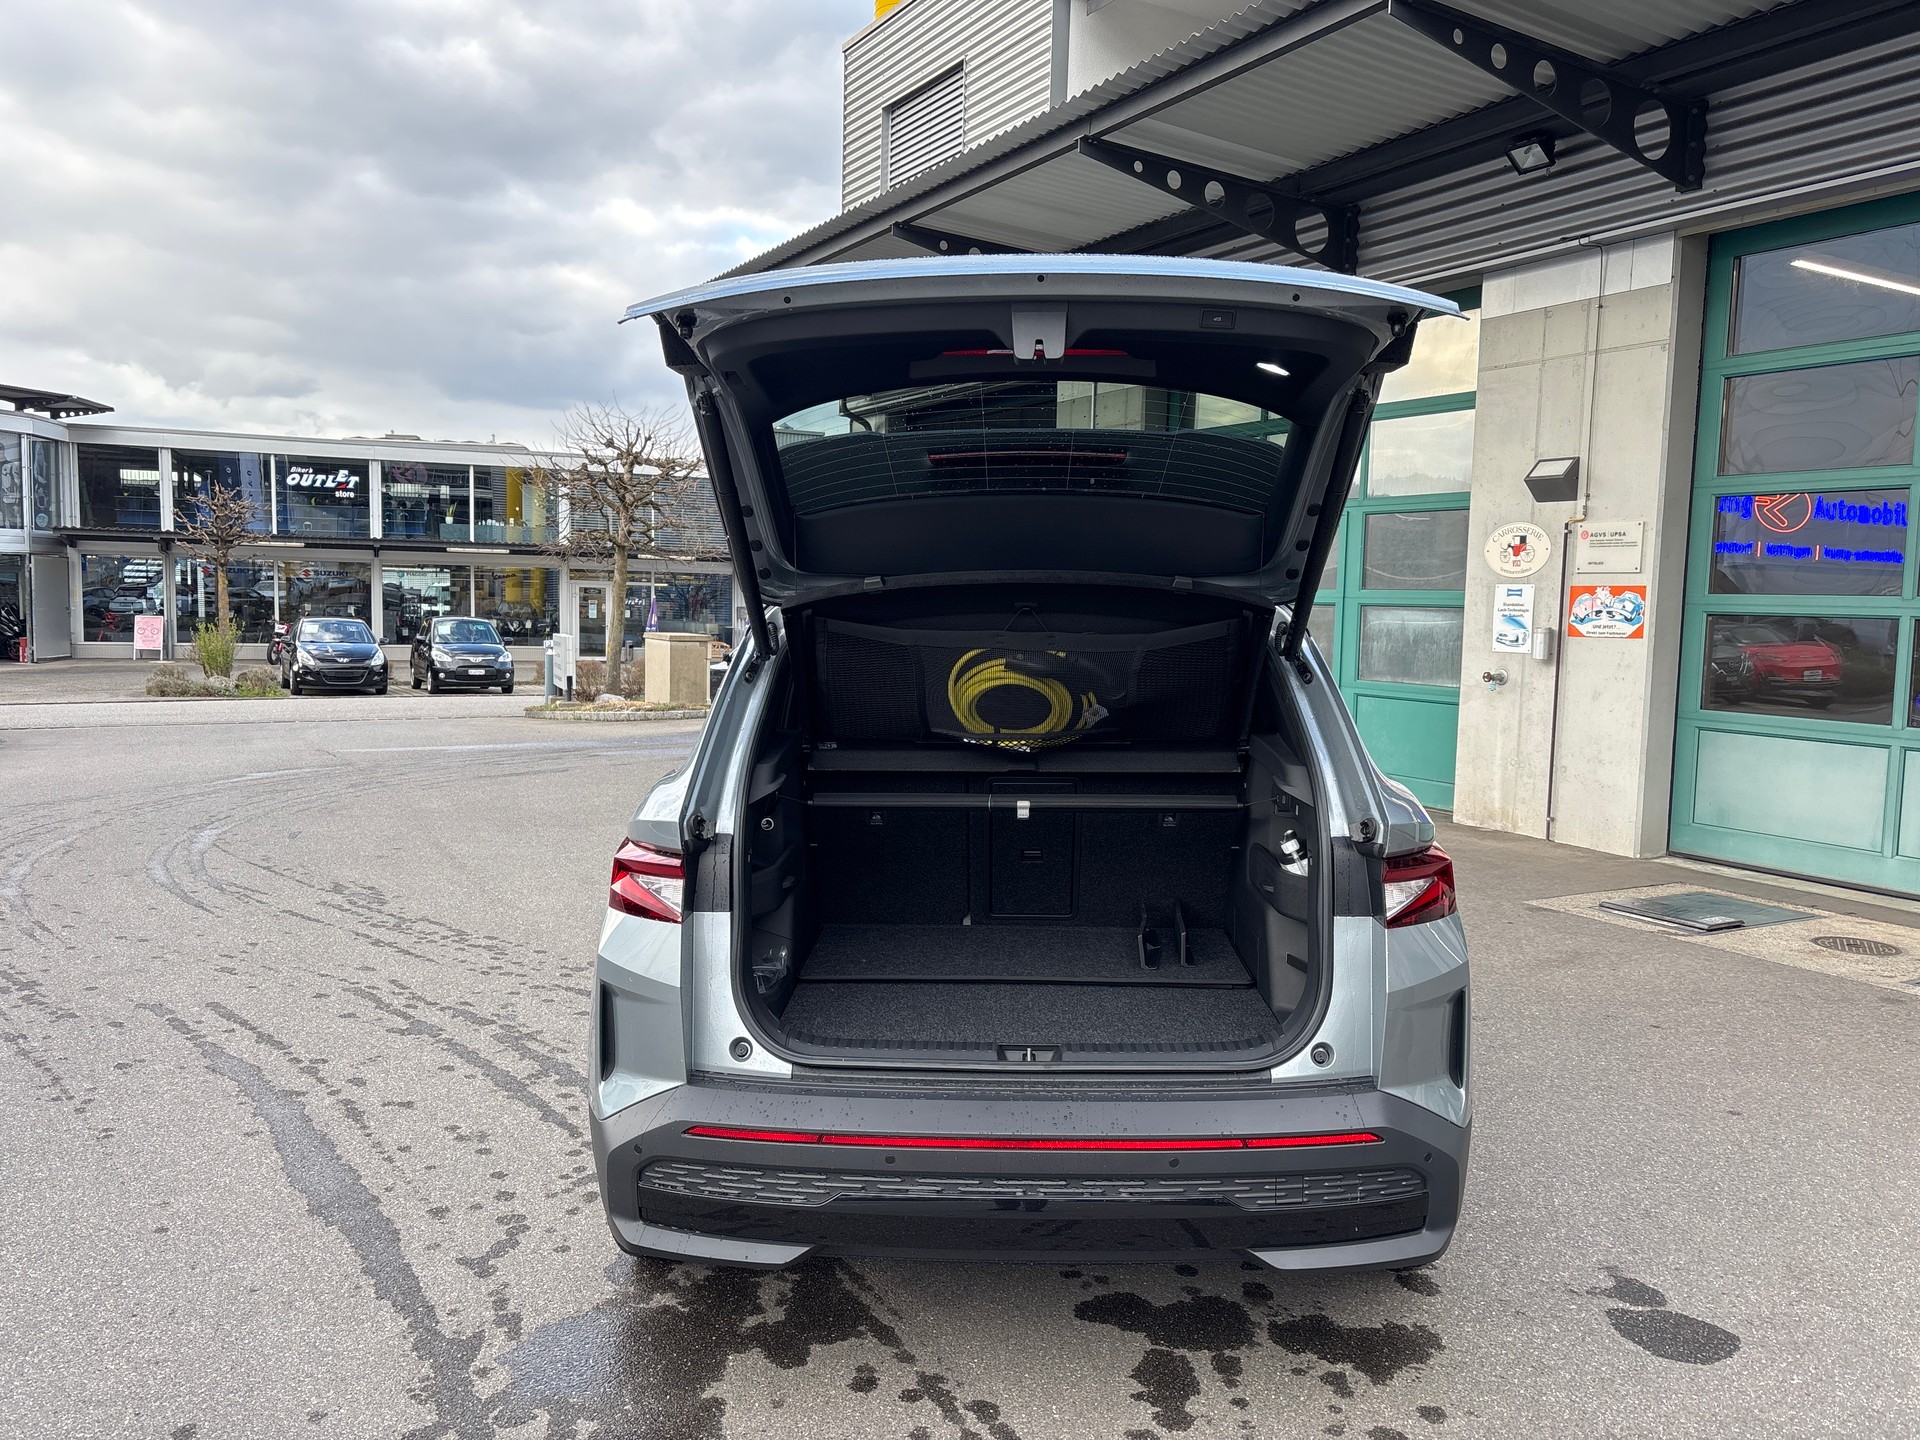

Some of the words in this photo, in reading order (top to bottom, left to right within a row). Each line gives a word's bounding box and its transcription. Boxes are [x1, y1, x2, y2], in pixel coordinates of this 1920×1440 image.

[286, 469, 360, 489] OUTLET
[335, 490, 355, 498] store
[1813, 495, 1909, 528] Automobil
[1492, 525, 1544, 543] CARROSSERIE
